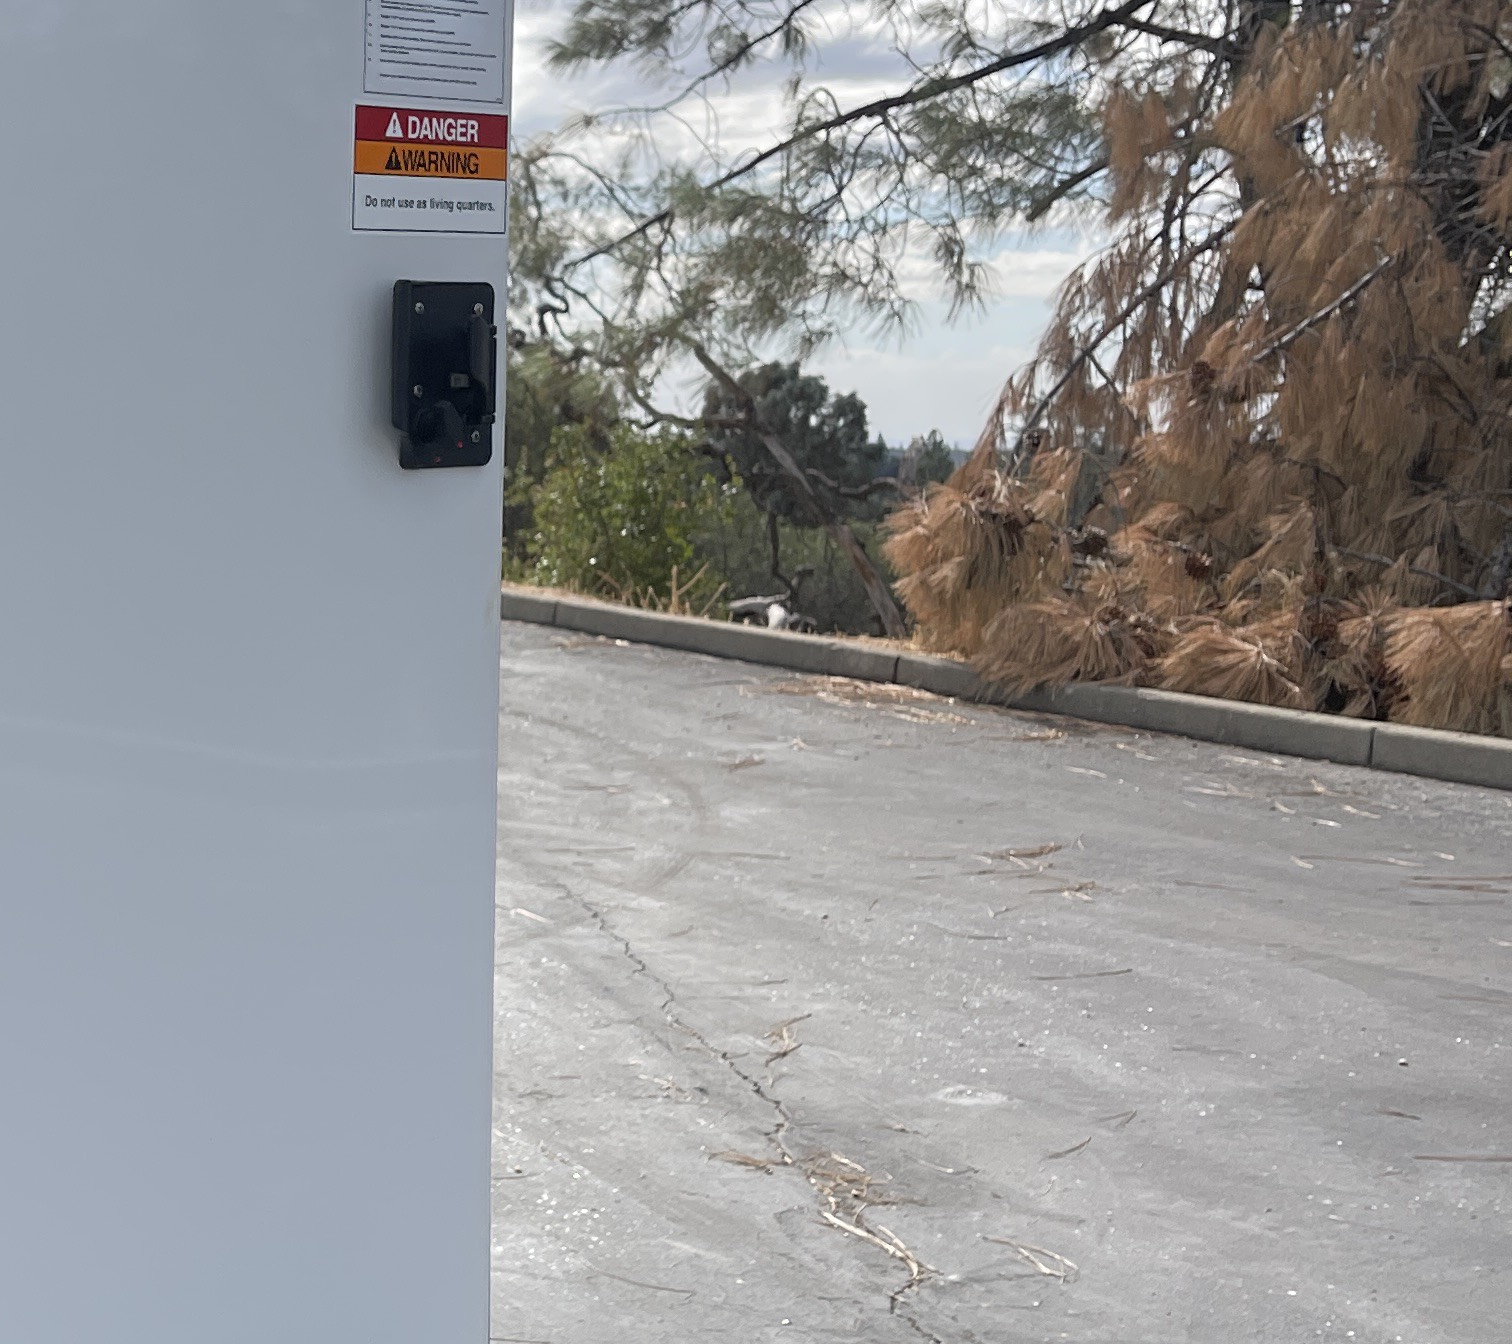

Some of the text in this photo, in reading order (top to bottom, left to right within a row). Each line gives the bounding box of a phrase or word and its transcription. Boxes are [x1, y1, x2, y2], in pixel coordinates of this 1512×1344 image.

[407, 115, 479, 142] DANGER
[402, 149, 480, 175] WARNING
[365, 195, 495, 213] Do not use as living quarters.
